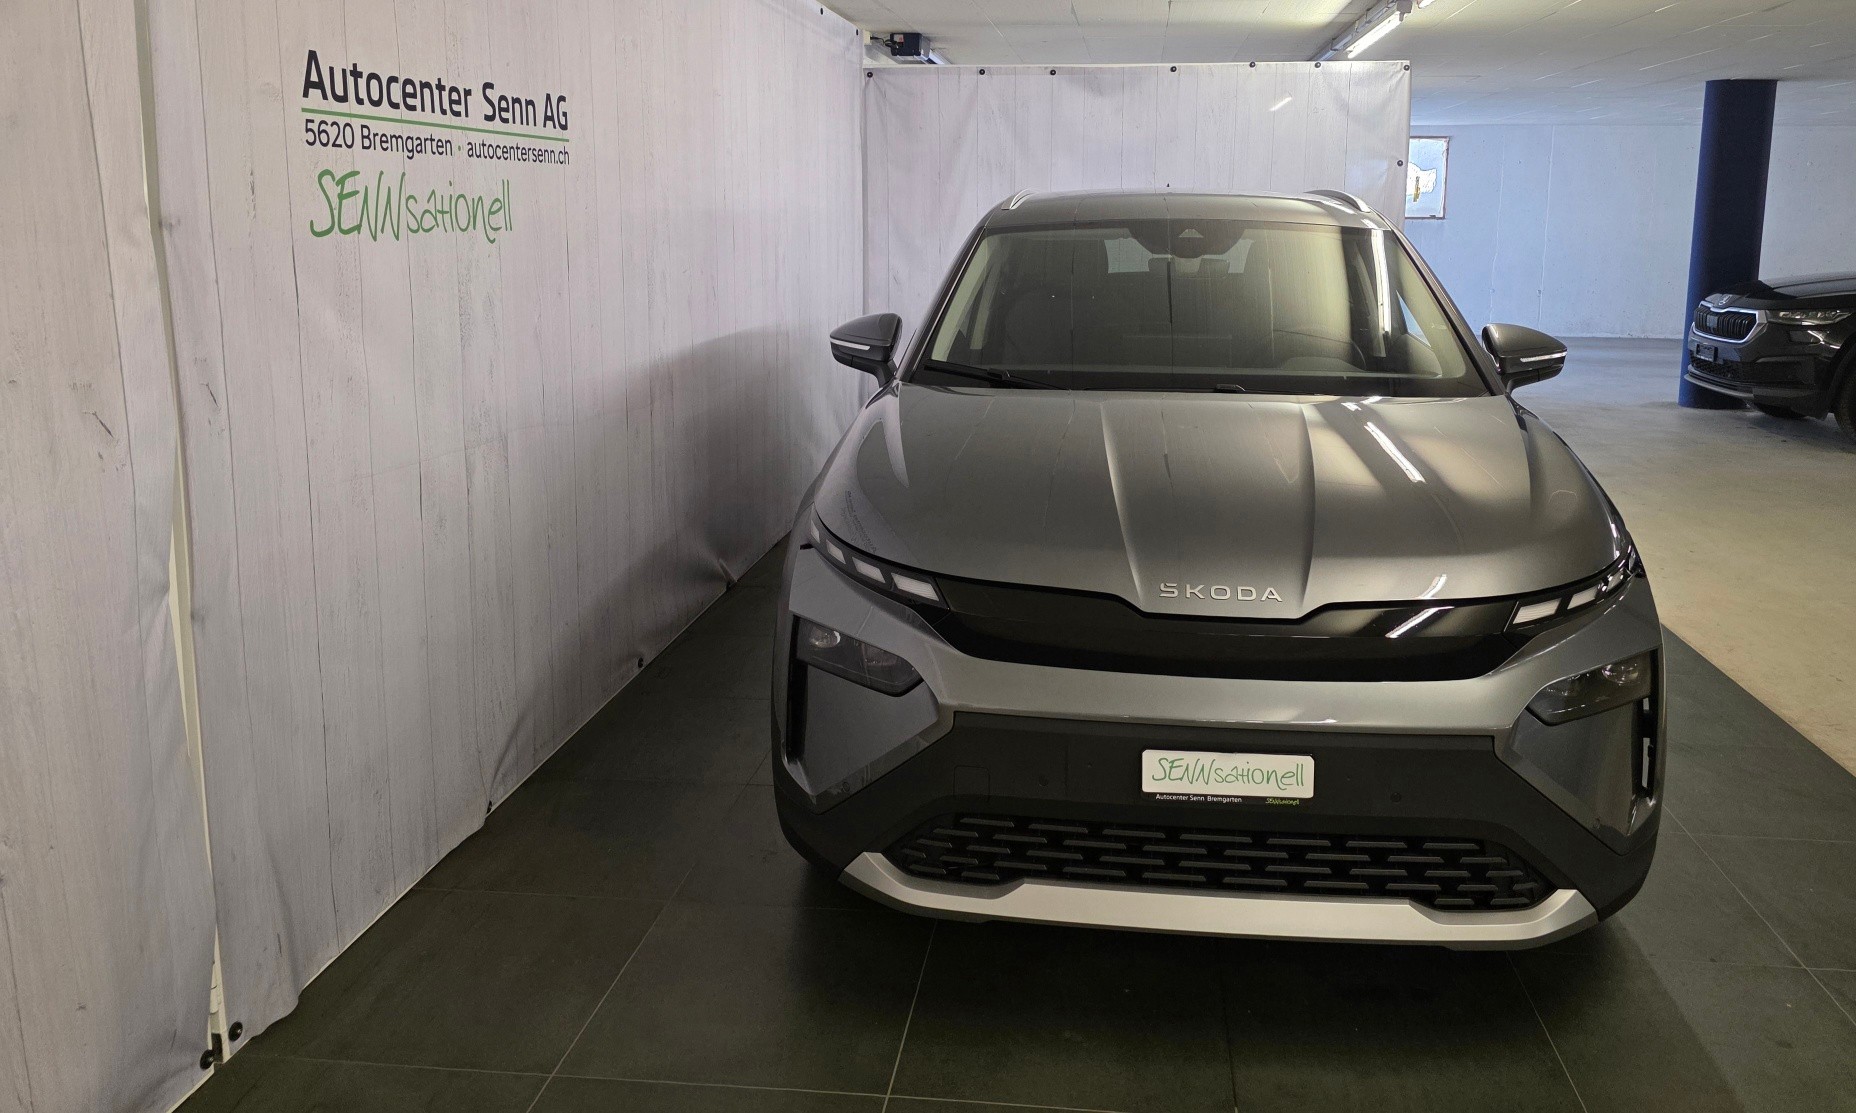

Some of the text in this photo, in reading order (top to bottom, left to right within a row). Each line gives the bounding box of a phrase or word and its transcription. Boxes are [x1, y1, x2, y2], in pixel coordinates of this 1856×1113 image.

[302, 49, 569, 131] Autocenter Senn AG
[304, 118, 570, 166] 5620 Bremgarten autocentersenn.ch
[309, 168, 513, 244] SENNsationell
[1151, 757, 1305, 791] SENNsationell
[1155, 793, 1189, 801] Autocenter
[1207, 795, 1242, 804] Bremgarten
